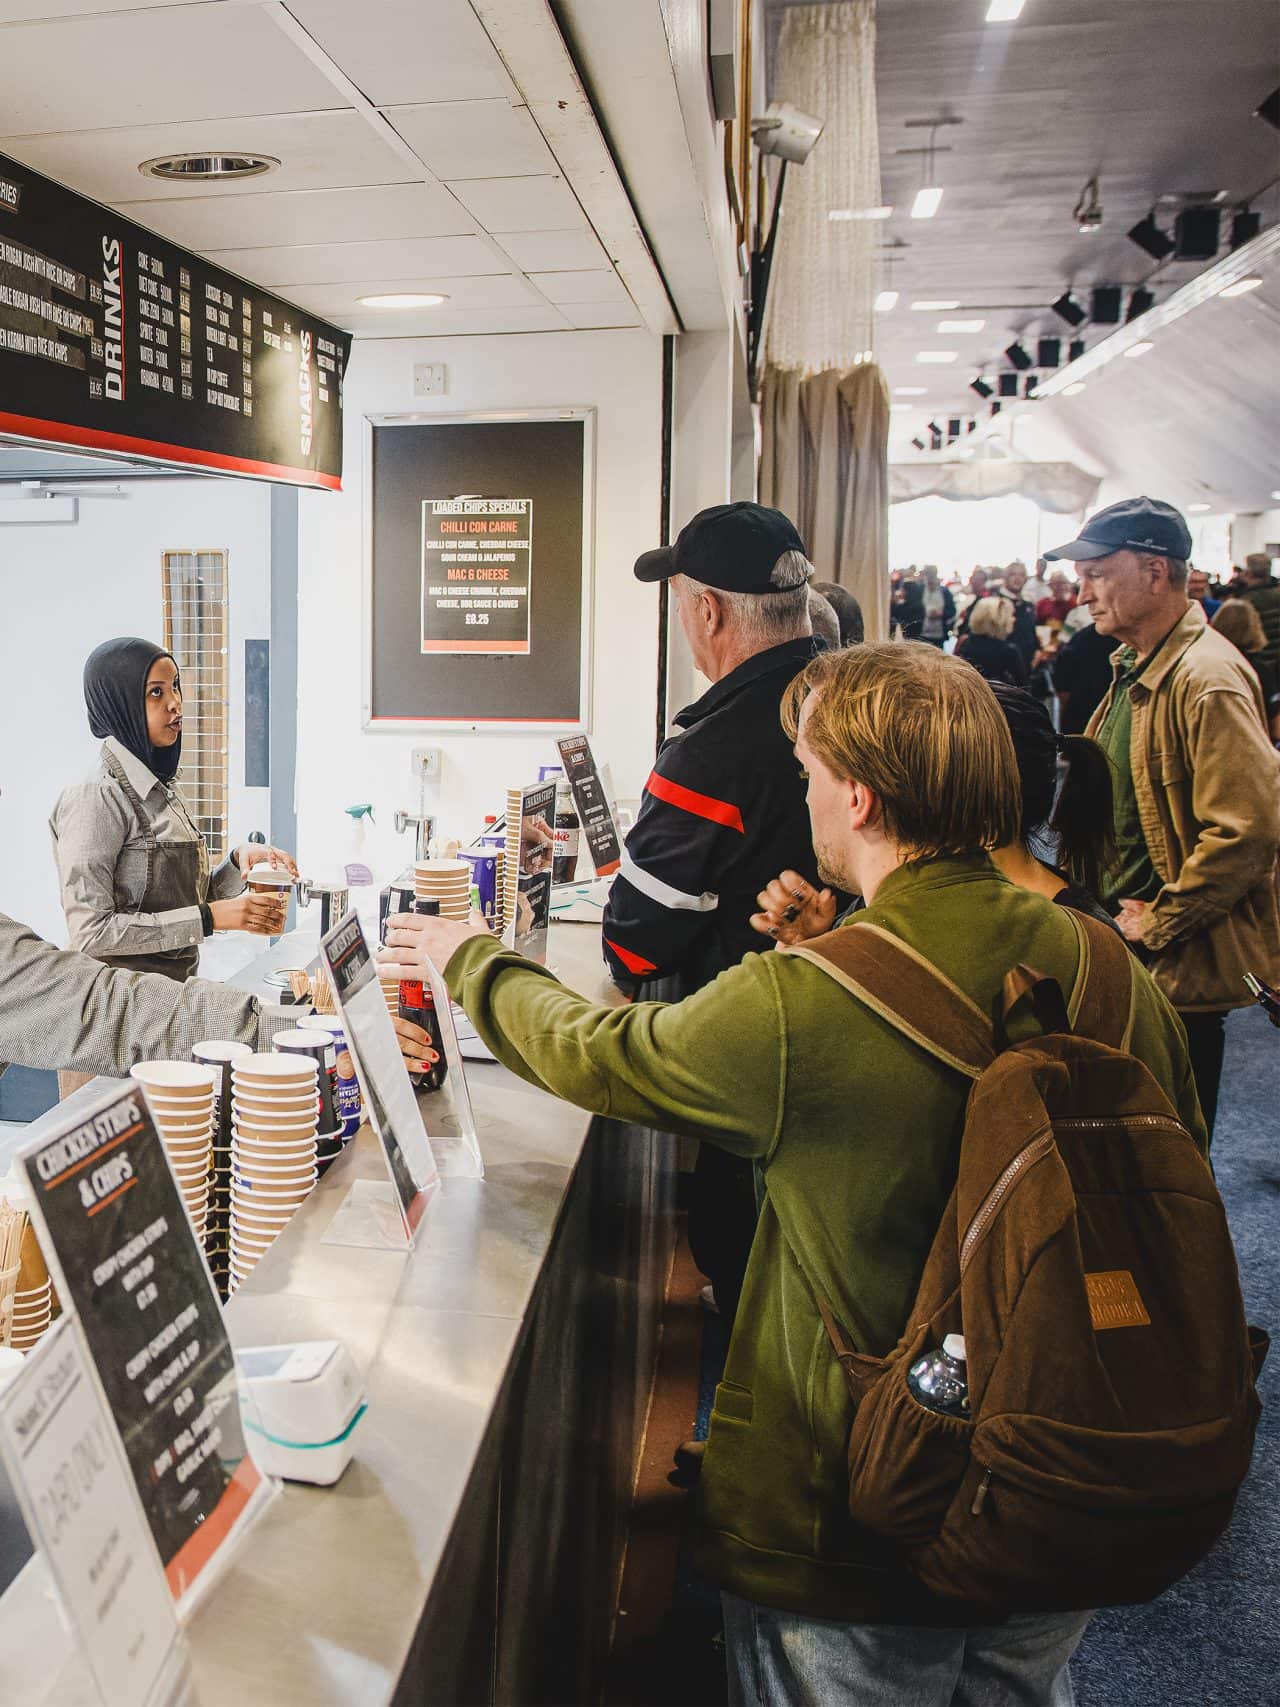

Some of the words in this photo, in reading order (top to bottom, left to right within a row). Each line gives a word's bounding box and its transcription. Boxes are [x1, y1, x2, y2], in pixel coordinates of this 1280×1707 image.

[102, 235, 122, 400] DRINKS
[299, 330, 311, 456] SNACKS
[440, 521, 467, 533] CHILLI
[469, 521, 487, 533] CON
[489, 521, 518, 533] CARNE
[464, 502, 487, 512] CHIPS
[448, 569, 466, 580] MAC
[468, 569, 474, 580] &
[476, 569, 509, 580] CHEESE
[36, 1119, 100, 1181] CHICKEN
[91, 1152, 133, 1198] CHIPS
